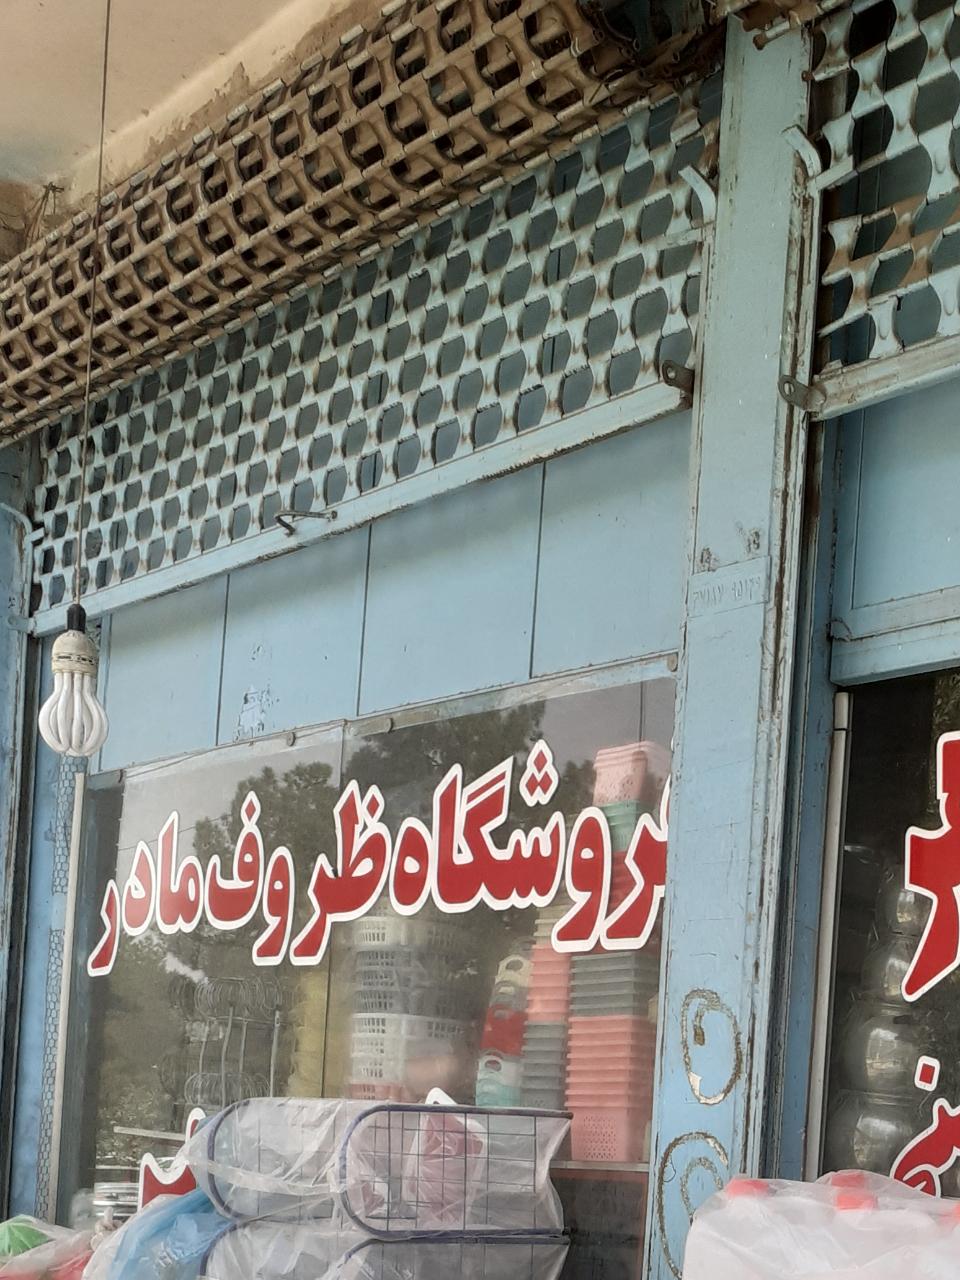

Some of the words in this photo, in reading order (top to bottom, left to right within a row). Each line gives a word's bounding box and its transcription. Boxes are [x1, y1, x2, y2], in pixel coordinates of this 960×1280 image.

[87, 809, 205, 977] مادر
[205, 779, 393, 967] ظروف
[388, 739, 670, 954] روشگاه
